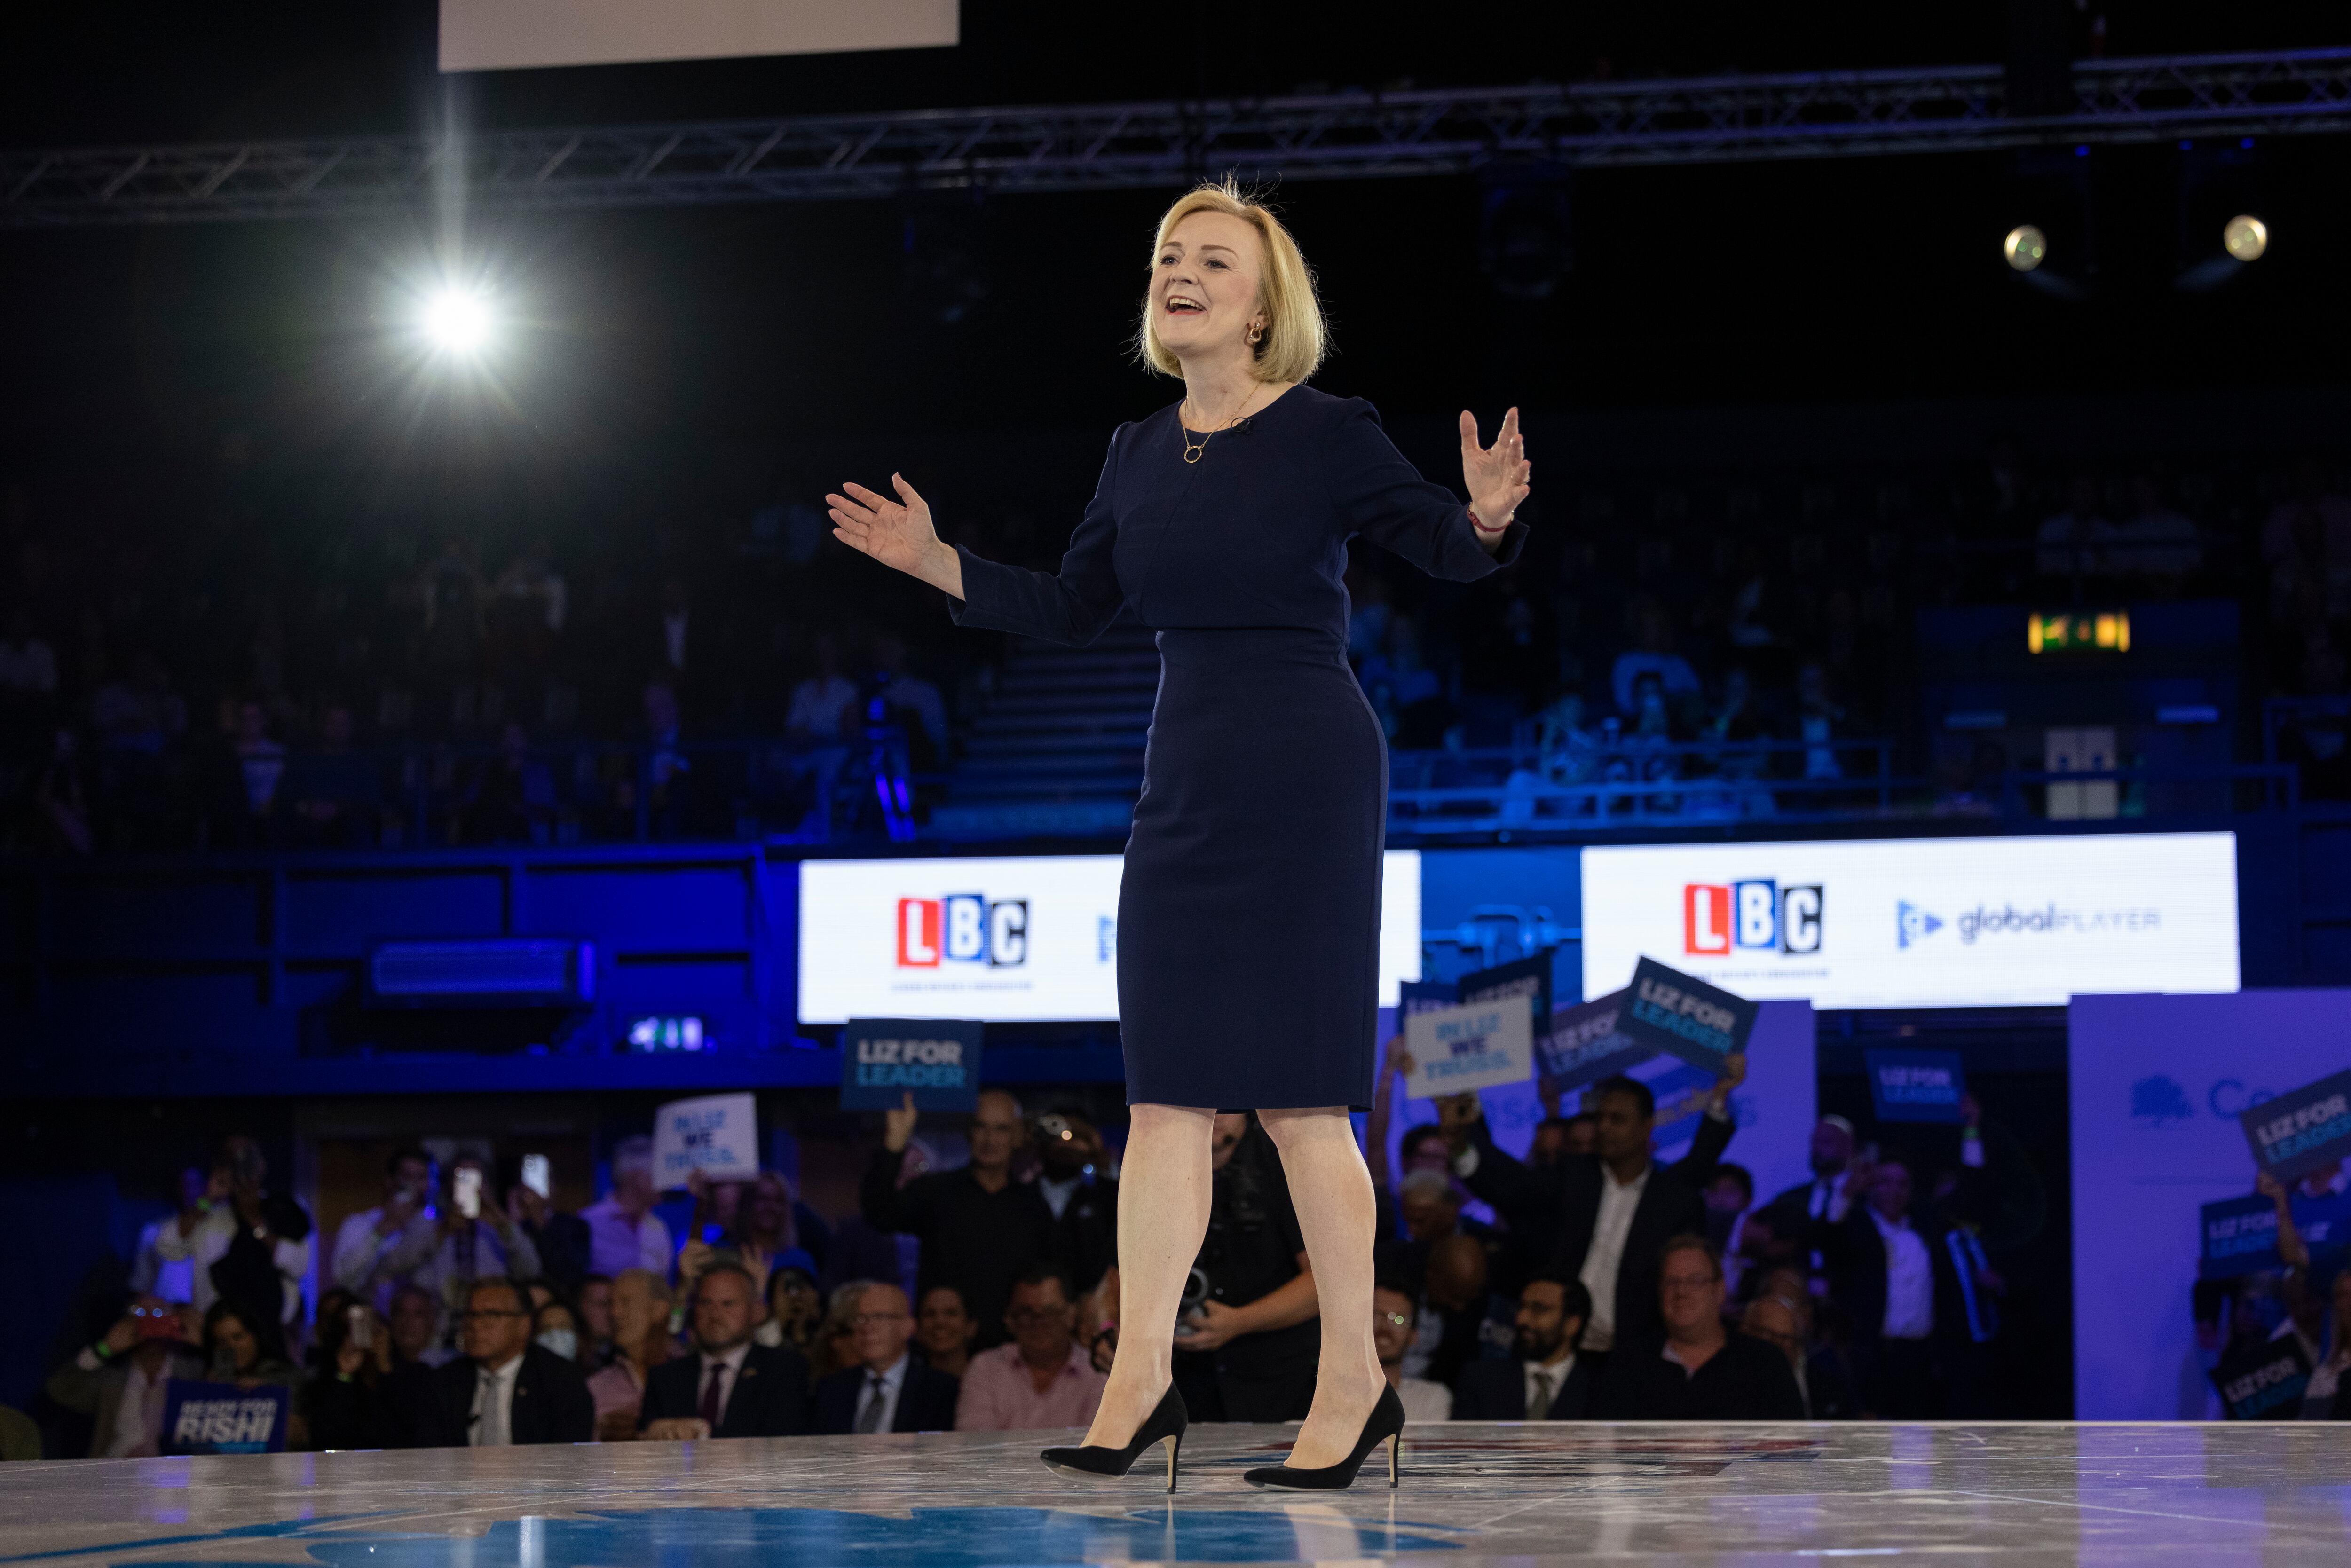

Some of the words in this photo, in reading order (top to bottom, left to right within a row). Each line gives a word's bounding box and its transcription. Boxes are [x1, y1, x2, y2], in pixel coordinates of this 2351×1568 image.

[898, 894, 1028, 967] LBC
[1686, 881, 1822, 955] LBC
[1632, 1000, 1734, 1054] LEADER
[1639, 977, 1682, 1012] LIZ
[1679, 995, 1736, 1033] FOR
[856, 1063, 966, 1088] LEADER
[857, 1039, 900, 1064] LIZ
[902, 1039, 963, 1064] FOR
[2256, 1113, 2295, 1146] LIZ
[2295, 1093, 2347, 1130] FOR
[173, 1416, 276, 1444] RISHI
